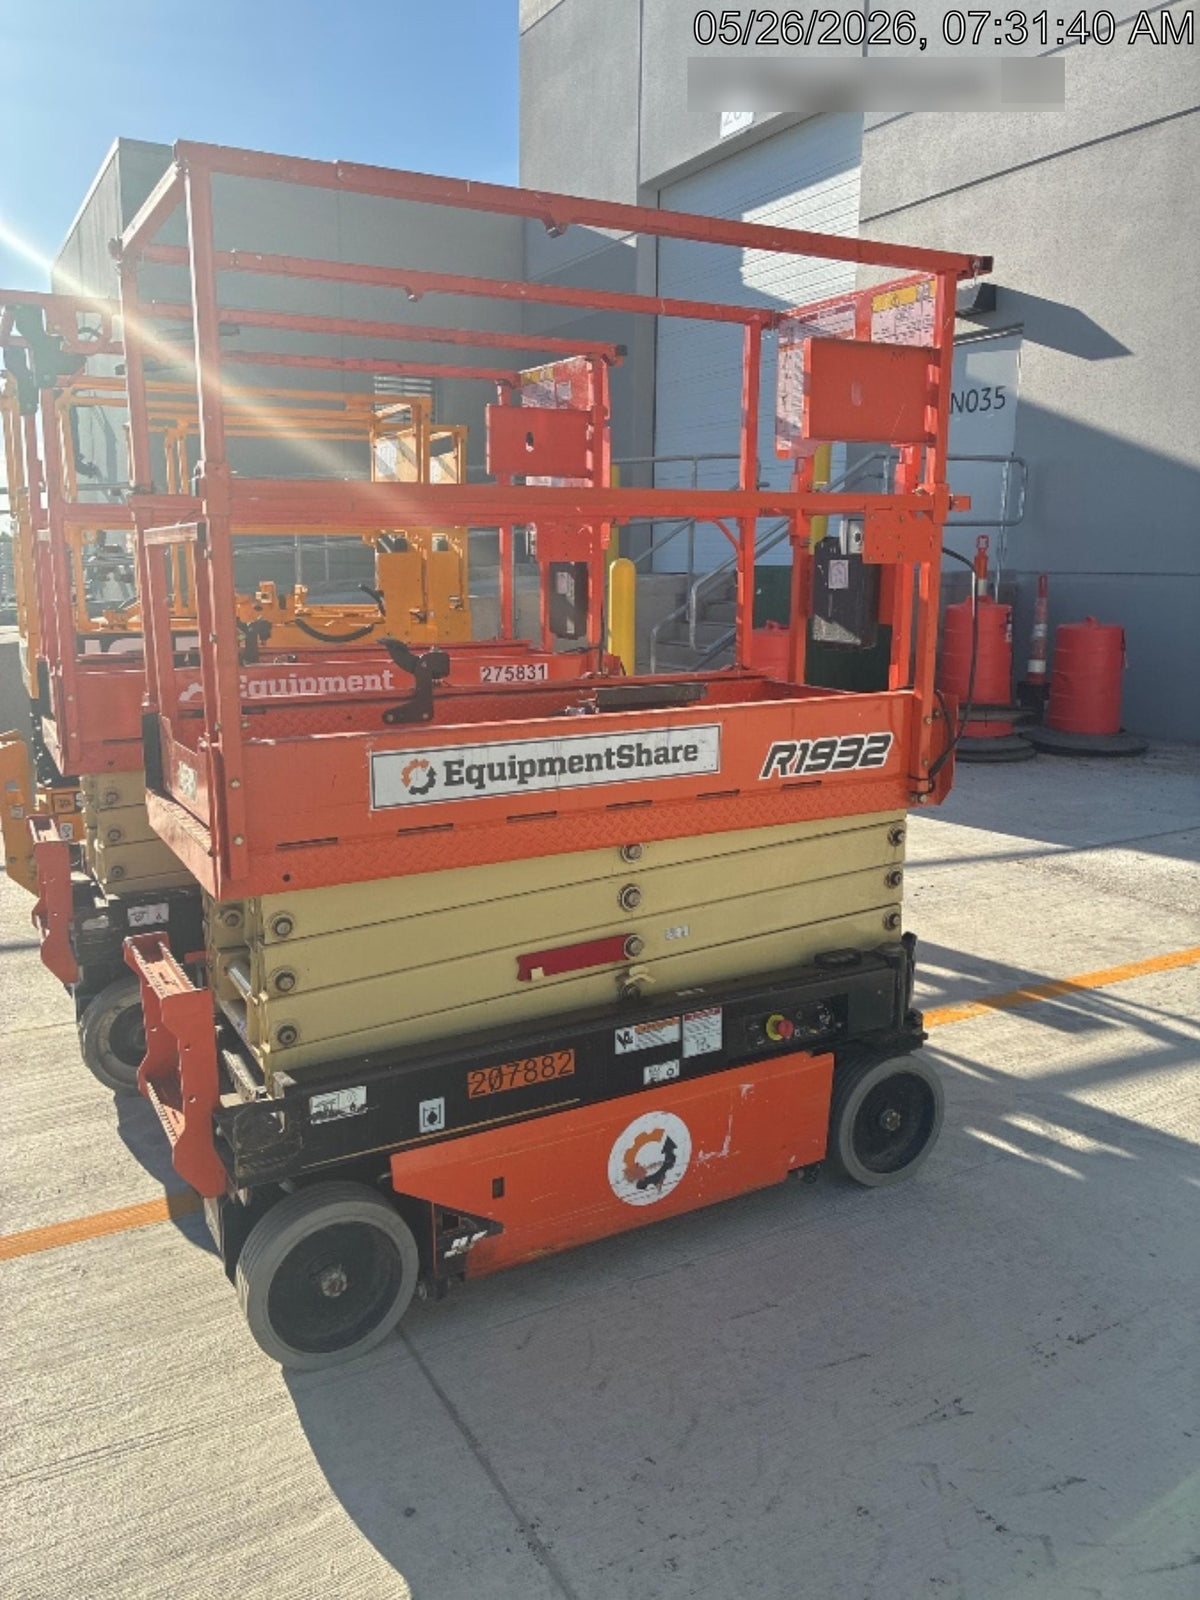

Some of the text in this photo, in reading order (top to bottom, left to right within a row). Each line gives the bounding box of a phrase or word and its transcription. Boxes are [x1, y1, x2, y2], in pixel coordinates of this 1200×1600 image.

[482, 664, 545, 682] 275831
[443, 743, 698, 789] EquipmentShare
[759, 731, 894, 780] R1932
[471, 1052, 573, 1096] 207882
